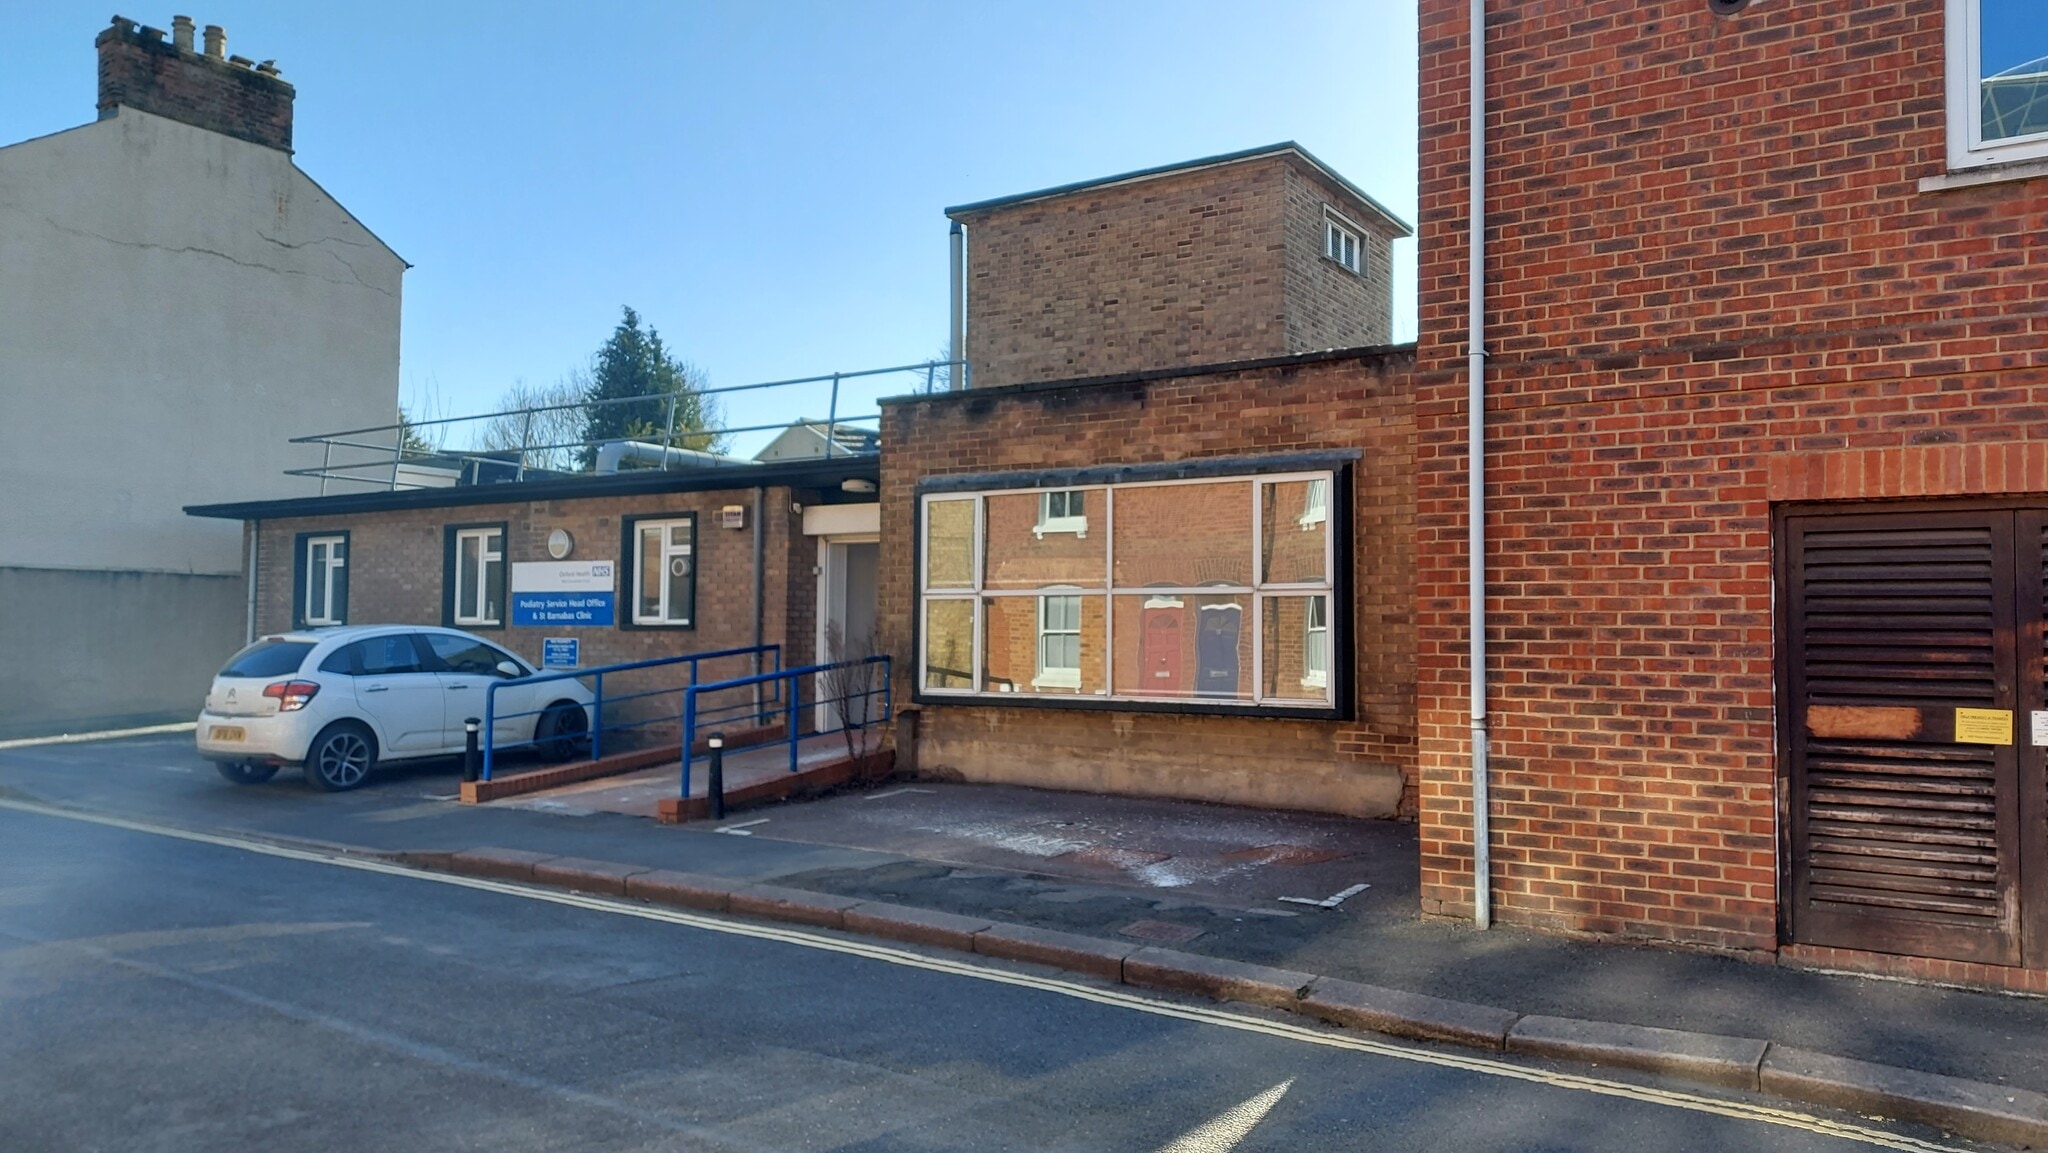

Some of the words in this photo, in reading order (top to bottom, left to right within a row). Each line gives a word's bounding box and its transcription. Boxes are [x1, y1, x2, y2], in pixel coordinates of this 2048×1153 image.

[592, 566, 610, 577] NHS
[520, 600, 545, 609] Podiatry
[546, 599, 567, 607] Service
[569, 599, 585, 607] Head
[586, 598, 606, 607] Office
[532, 611, 538, 620] &
[539, 611, 546, 620] St
[547, 611, 575, 620] Barnabas
[575, 610, 592, 620] Clinic
